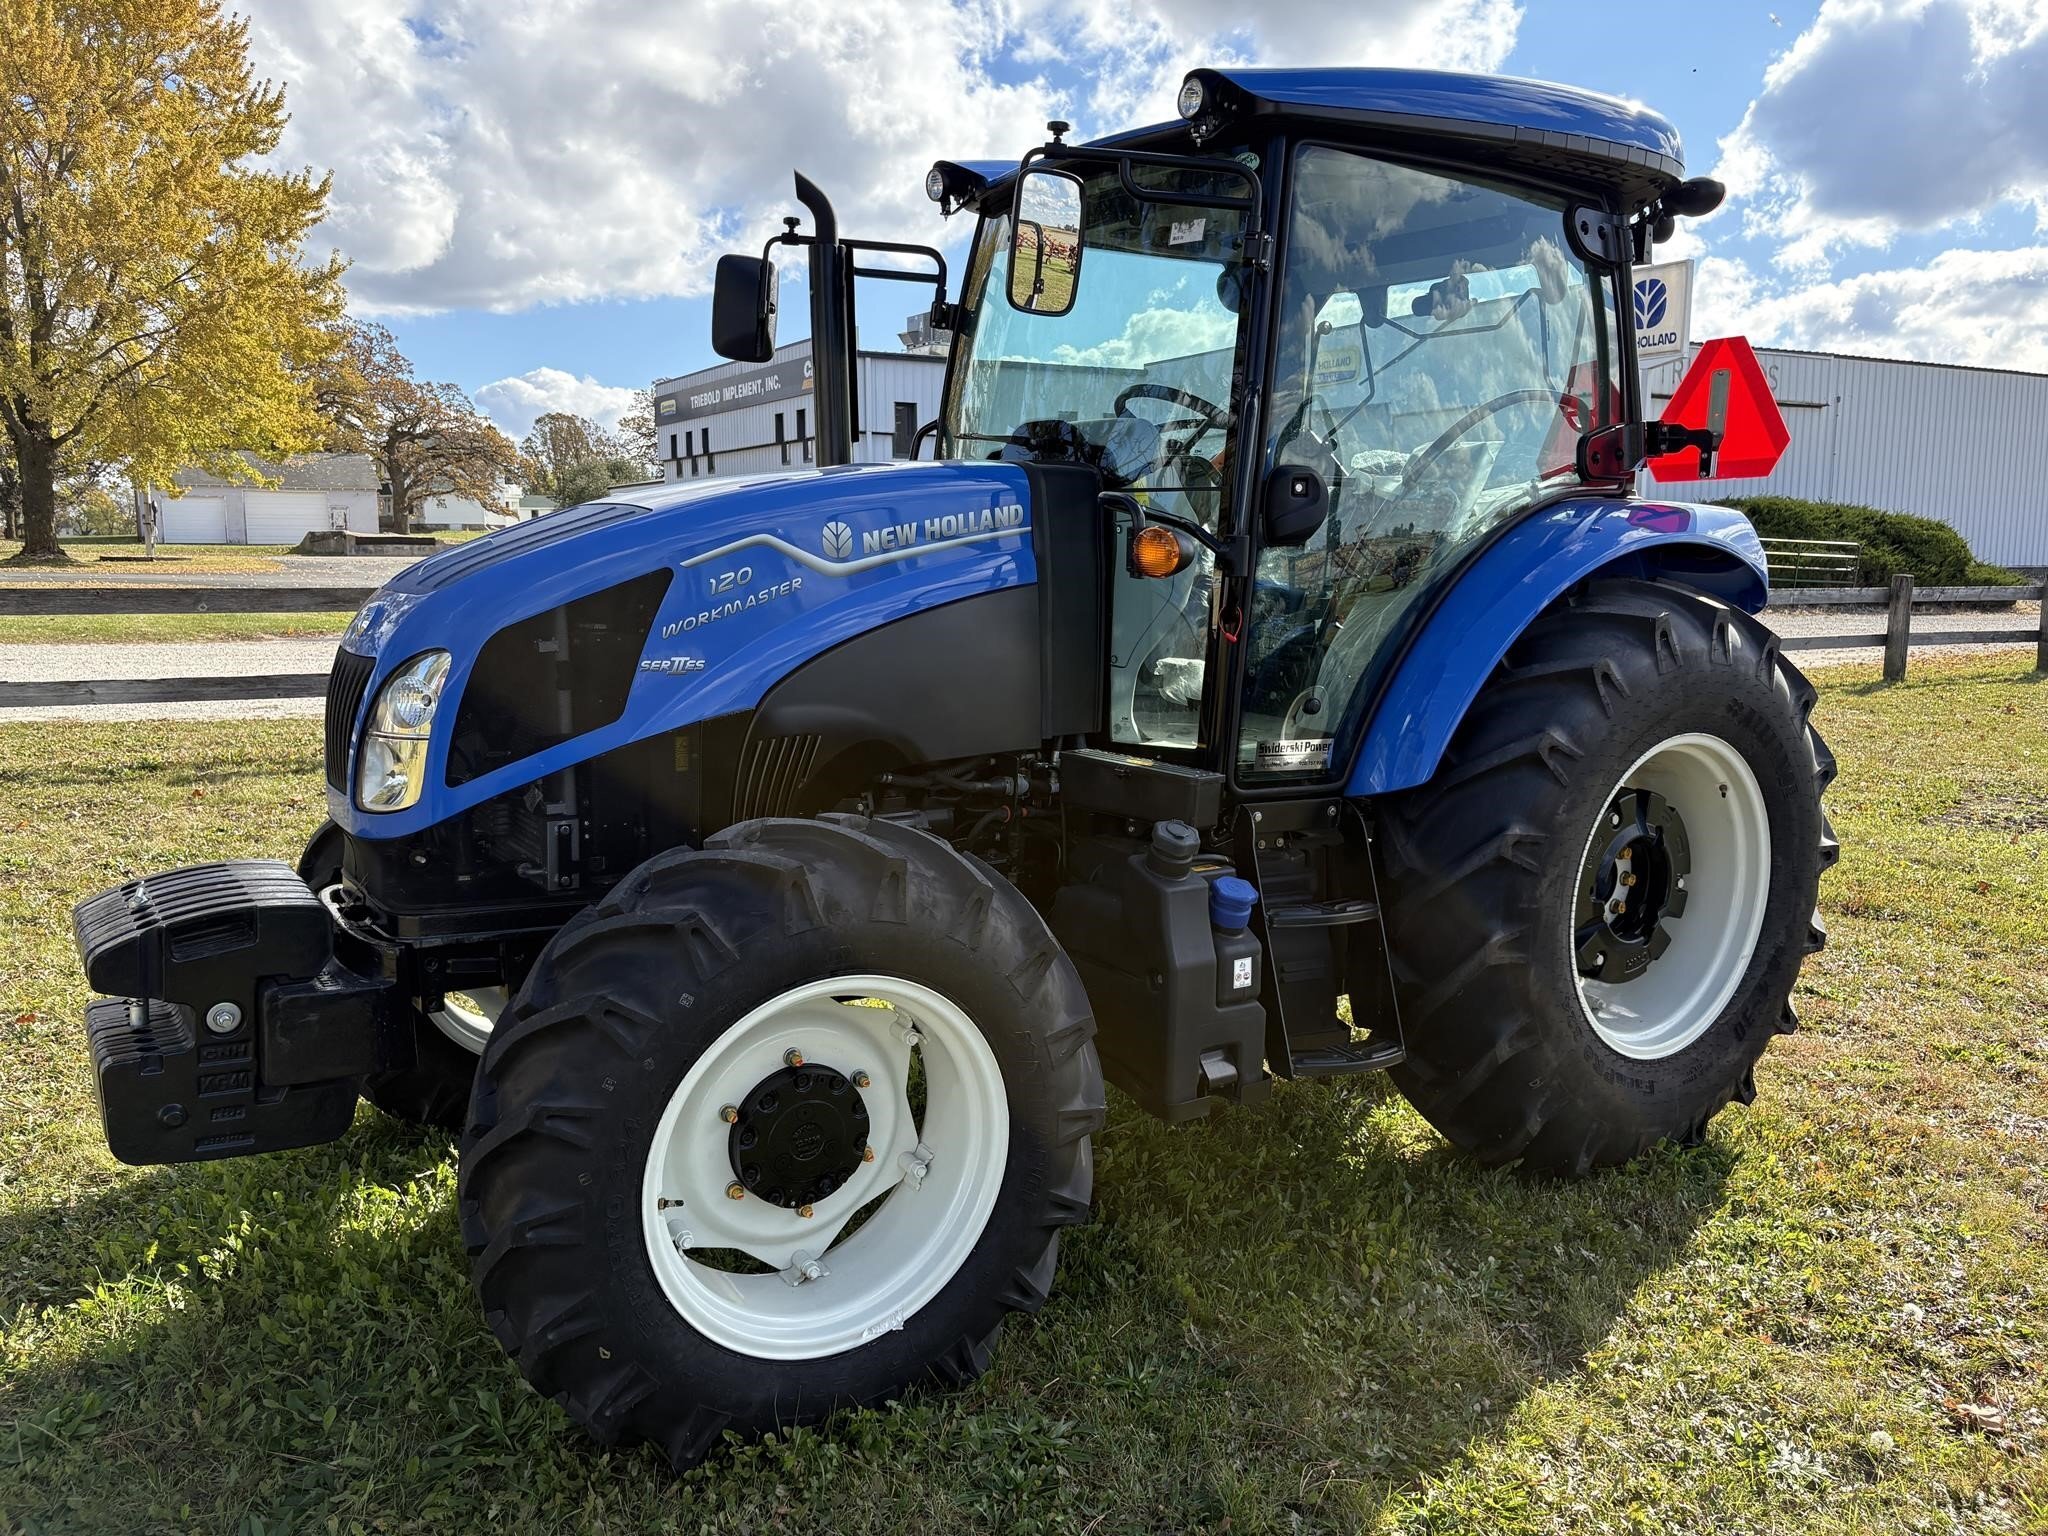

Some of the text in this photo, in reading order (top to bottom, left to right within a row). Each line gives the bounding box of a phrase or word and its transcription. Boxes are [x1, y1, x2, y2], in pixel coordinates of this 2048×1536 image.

[690, 389, 720, 409] TRIEBOLD
[723, 379, 765, 402] IMPLEMENT,
[765, 374, 781, 392] INC.
[862, 504, 1024, 554] NEW HOLLAND
[709, 566, 753, 595] 120
[662, 577, 803, 640] WORKMASTER
[1258, 741, 1333, 754] Swiderski Power
